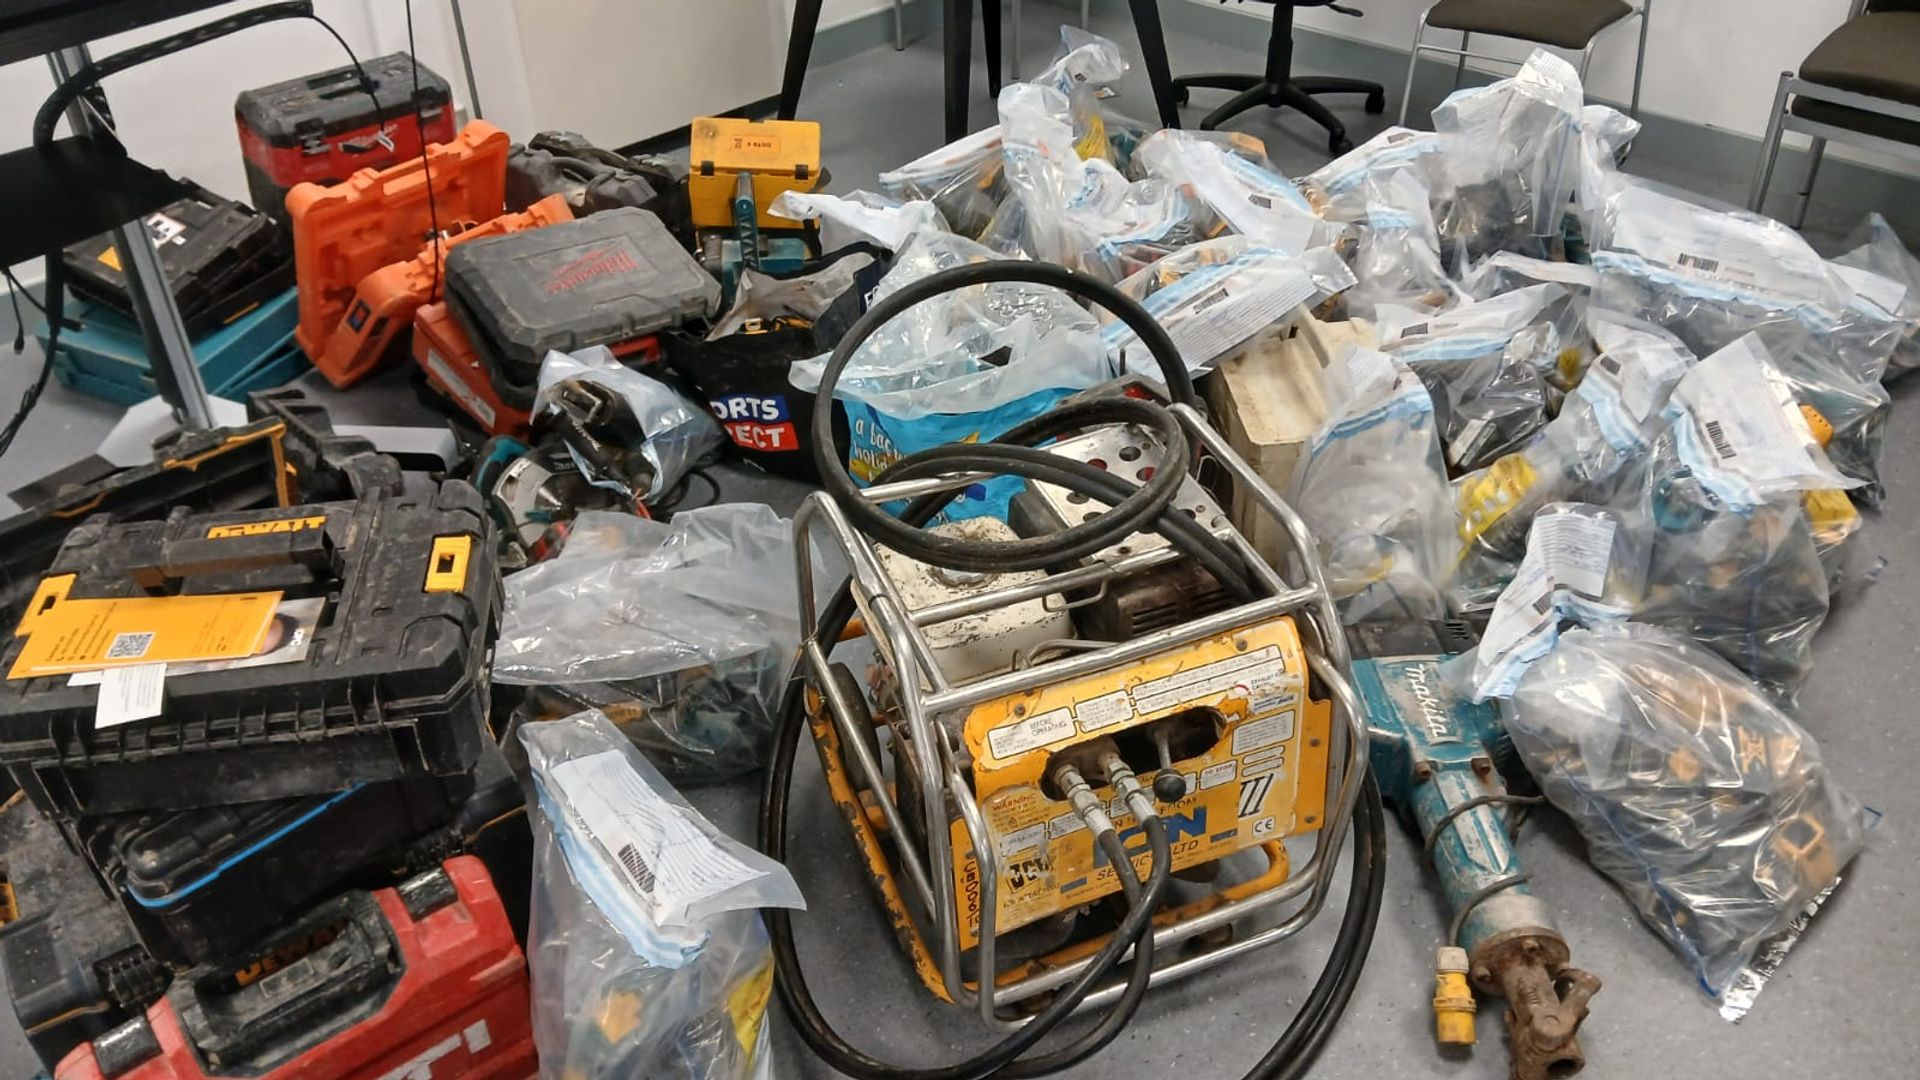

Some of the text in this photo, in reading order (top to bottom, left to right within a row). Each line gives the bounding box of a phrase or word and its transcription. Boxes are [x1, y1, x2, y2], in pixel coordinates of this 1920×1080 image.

[724, 425, 785, 448] ECT
[1404, 663, 1448, 737] makita
[1173, 839, 1199, 856] LTD
